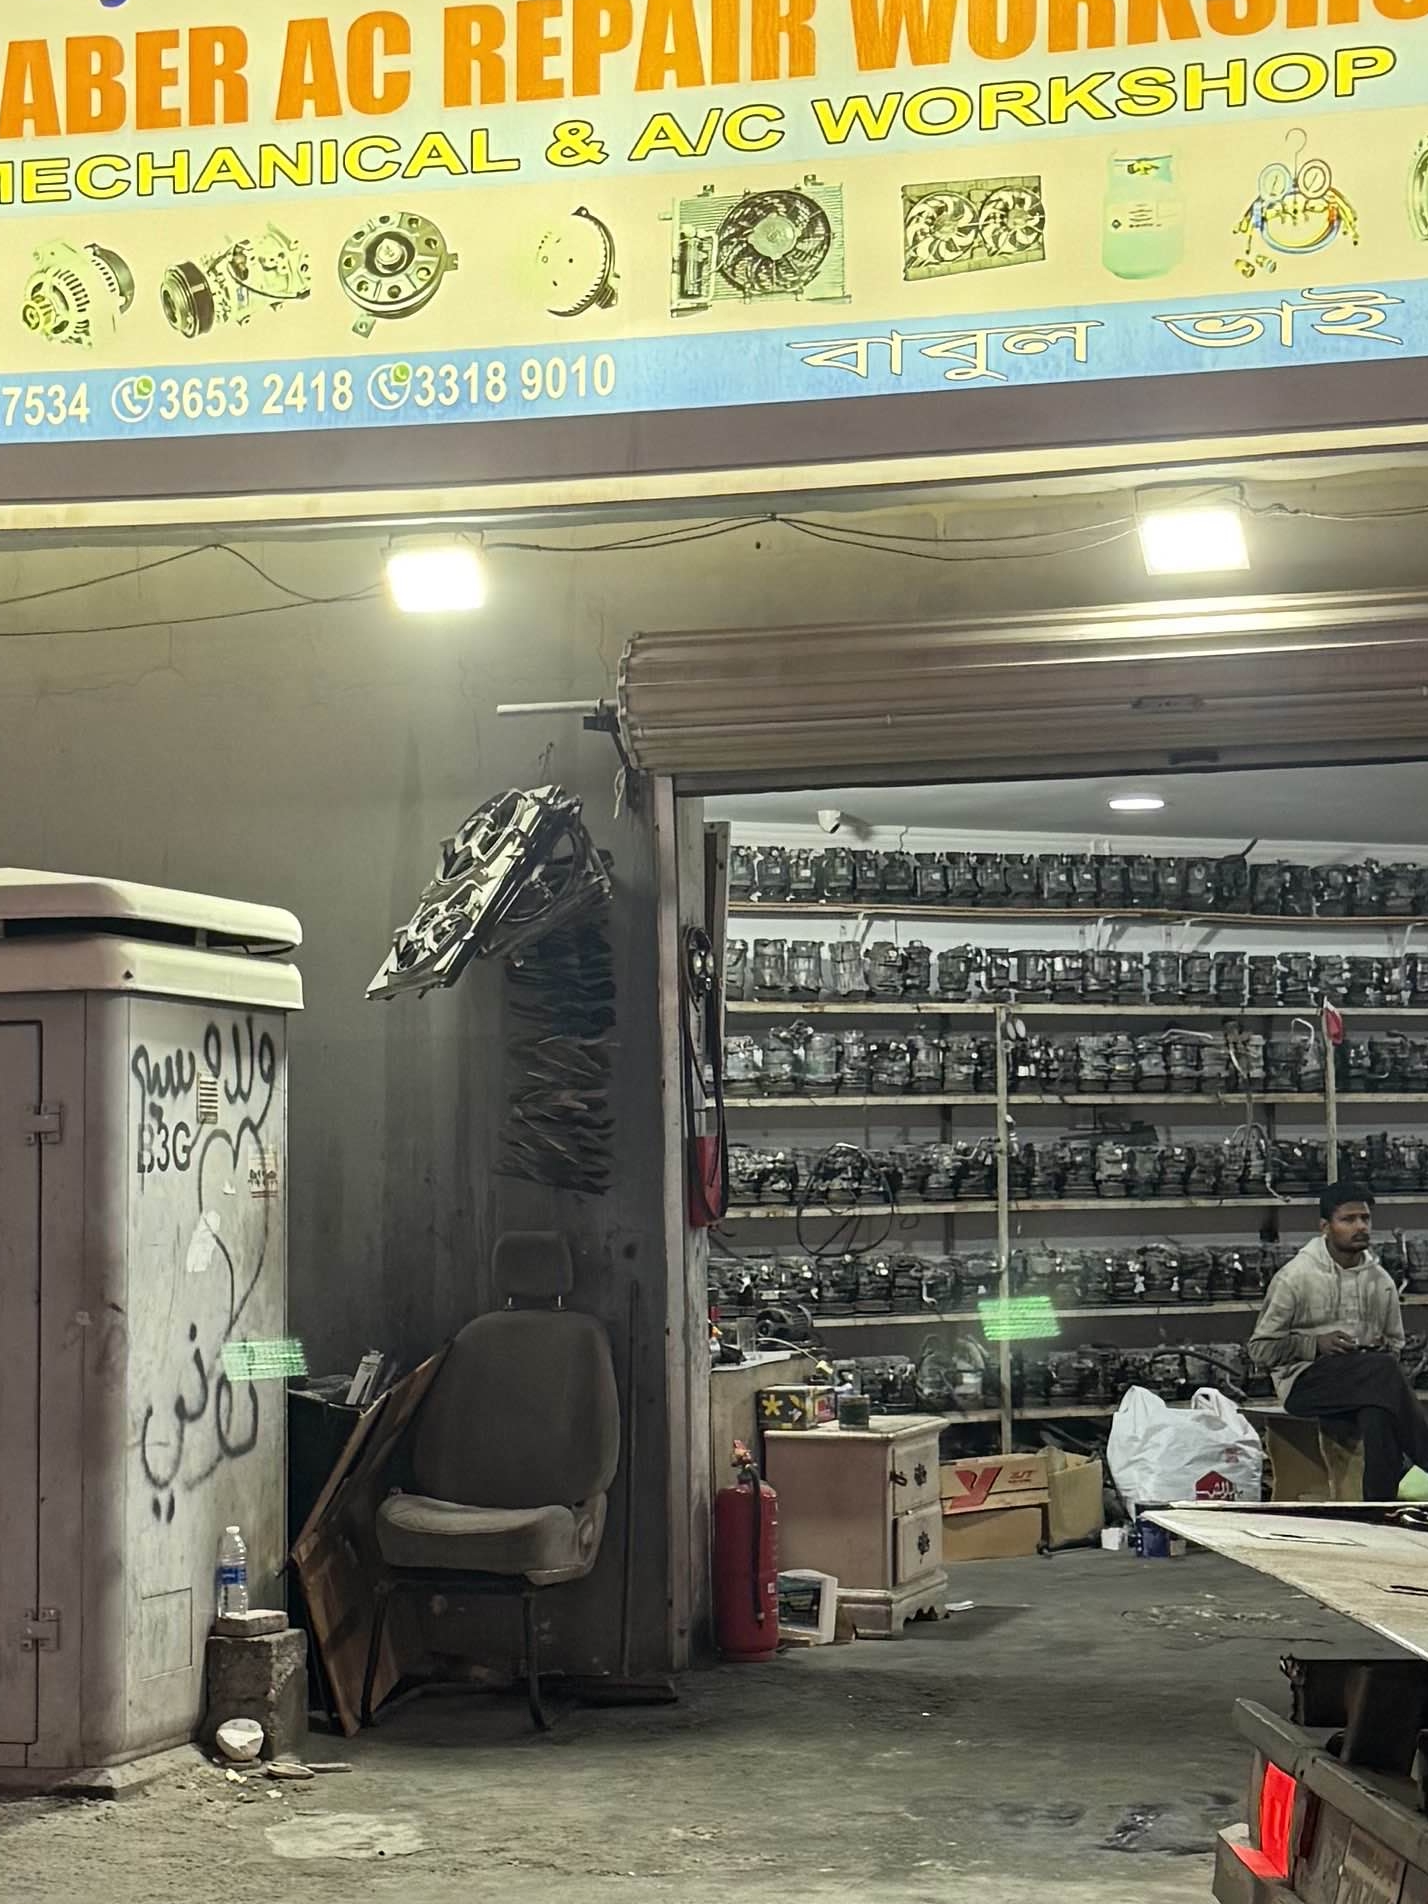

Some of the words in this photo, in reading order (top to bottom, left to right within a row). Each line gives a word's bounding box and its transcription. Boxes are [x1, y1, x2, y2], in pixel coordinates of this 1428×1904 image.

[275, 10, 413, 121] AC
[545, 121, 608, 166] &
[628, 105, 785, 161] A/C
[811, 46, 1396, 144] WORKSHOP
[785, 319, 1105, 382] বাবুল
[1151, 287, 1406, 348] ভাই
[2, 382, 90, 426] 7534
[159, 375, 249, 421] 3653
[262, 369, 354, 416] 2418
[415, 361, 506, 407] 3318
[520, 353, 616, 400] 9010
[137, 1121, 192, 1173] B3G
